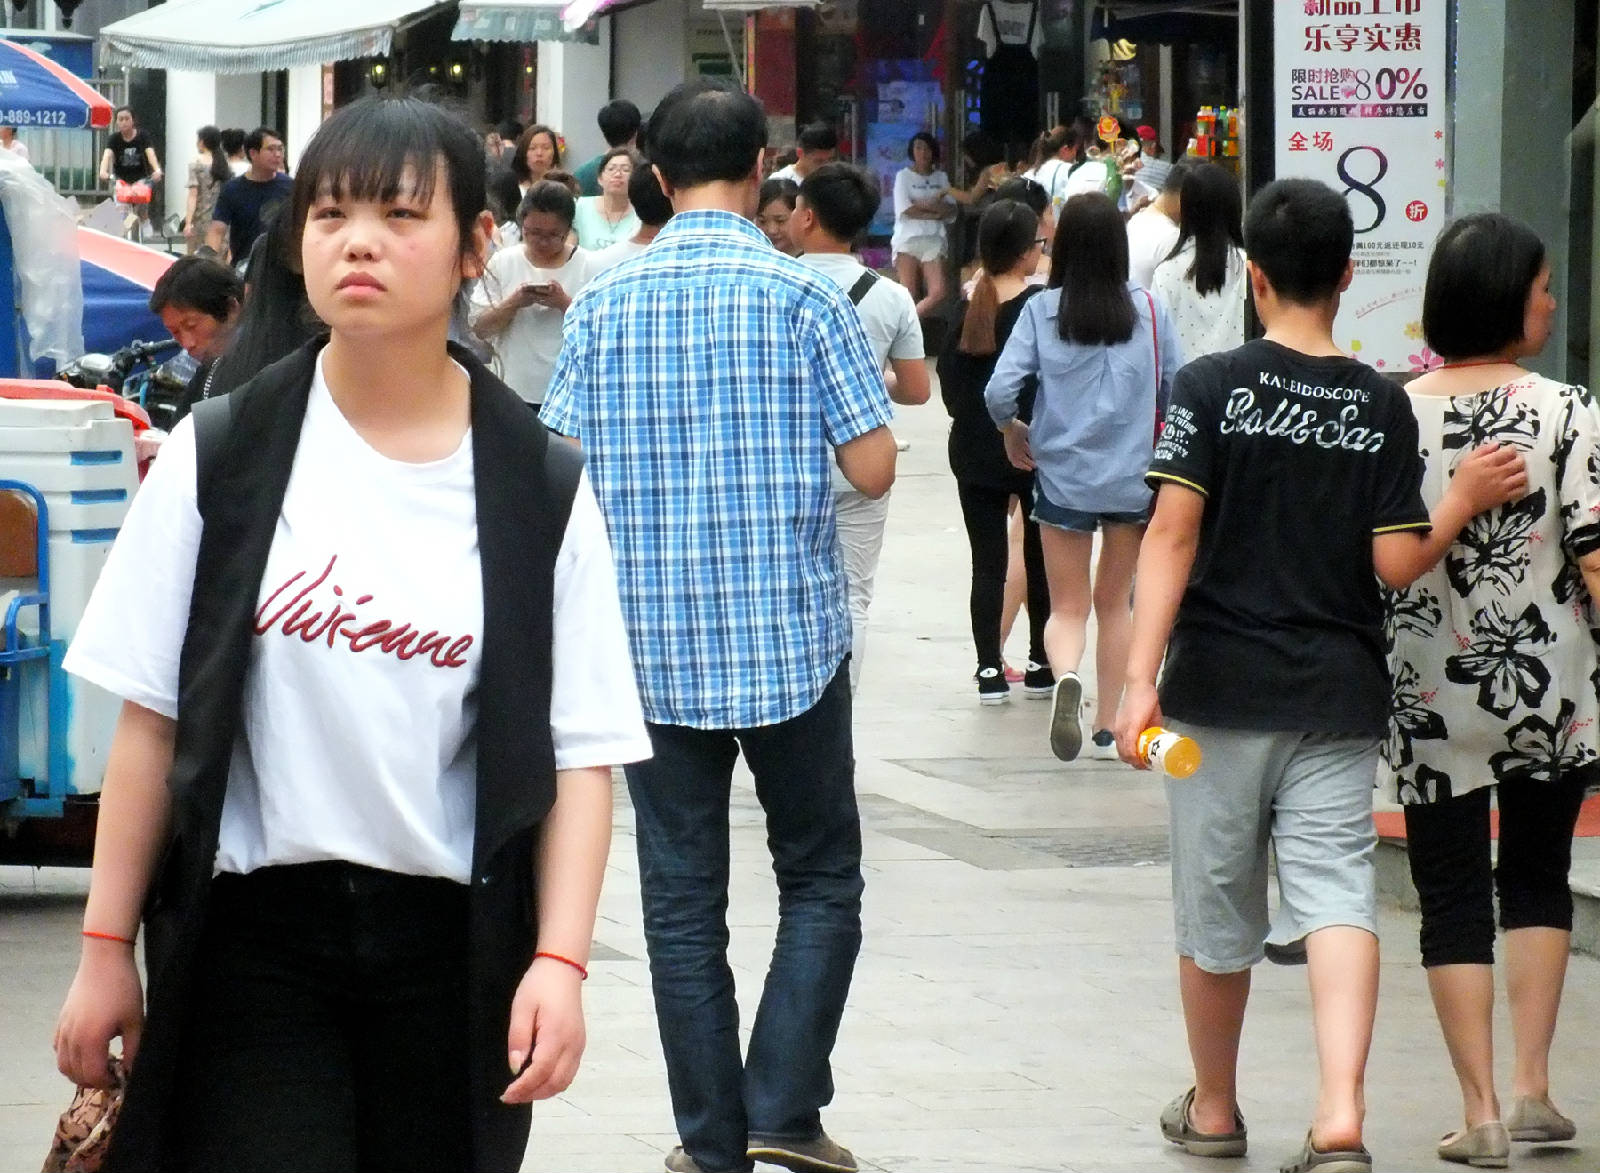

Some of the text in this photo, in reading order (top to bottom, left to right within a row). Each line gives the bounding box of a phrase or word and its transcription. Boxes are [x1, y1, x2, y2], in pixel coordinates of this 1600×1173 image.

[1303, 22, 1422, 52] 乐享实惠
[1292, 68, 1357, 84] 限时抢购
[1292, 85, 1341, 101] SALE
[1288, 131, 1333, 151] 全场
[1336, 146, 1388, 234] 8
[1409, 203, 1427, 220] 折
[1259, 371, 1370, 403] KALEIDOSCOPE
